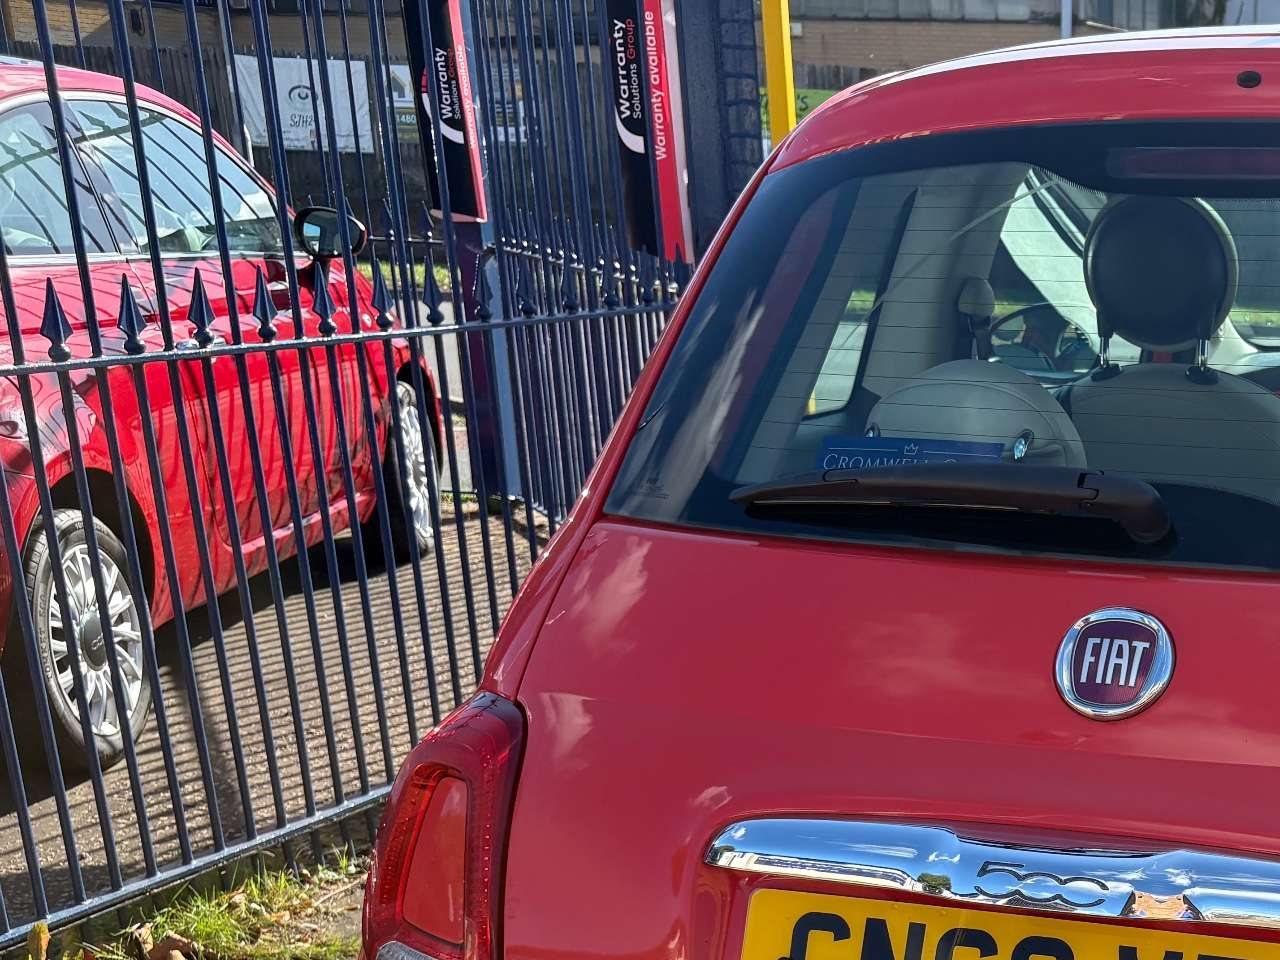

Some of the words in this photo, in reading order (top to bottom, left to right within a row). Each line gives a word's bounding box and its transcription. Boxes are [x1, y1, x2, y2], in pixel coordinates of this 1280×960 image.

[626, 18, 637, 60] Group
[645, 11, 660, 85] available
[435, 47, 453, 119] Warranty
[457, 44, 470, 96] available
[613, 19, 631, 119] Warranty
[630, 63, 642, 119] Solutions
[450, 80, 462, 120] Solutions
[651, 88, 667, 161] Warranty
[1079, 636, 1150, 688] FIAT
[974, 860, 1110, 908] 500
